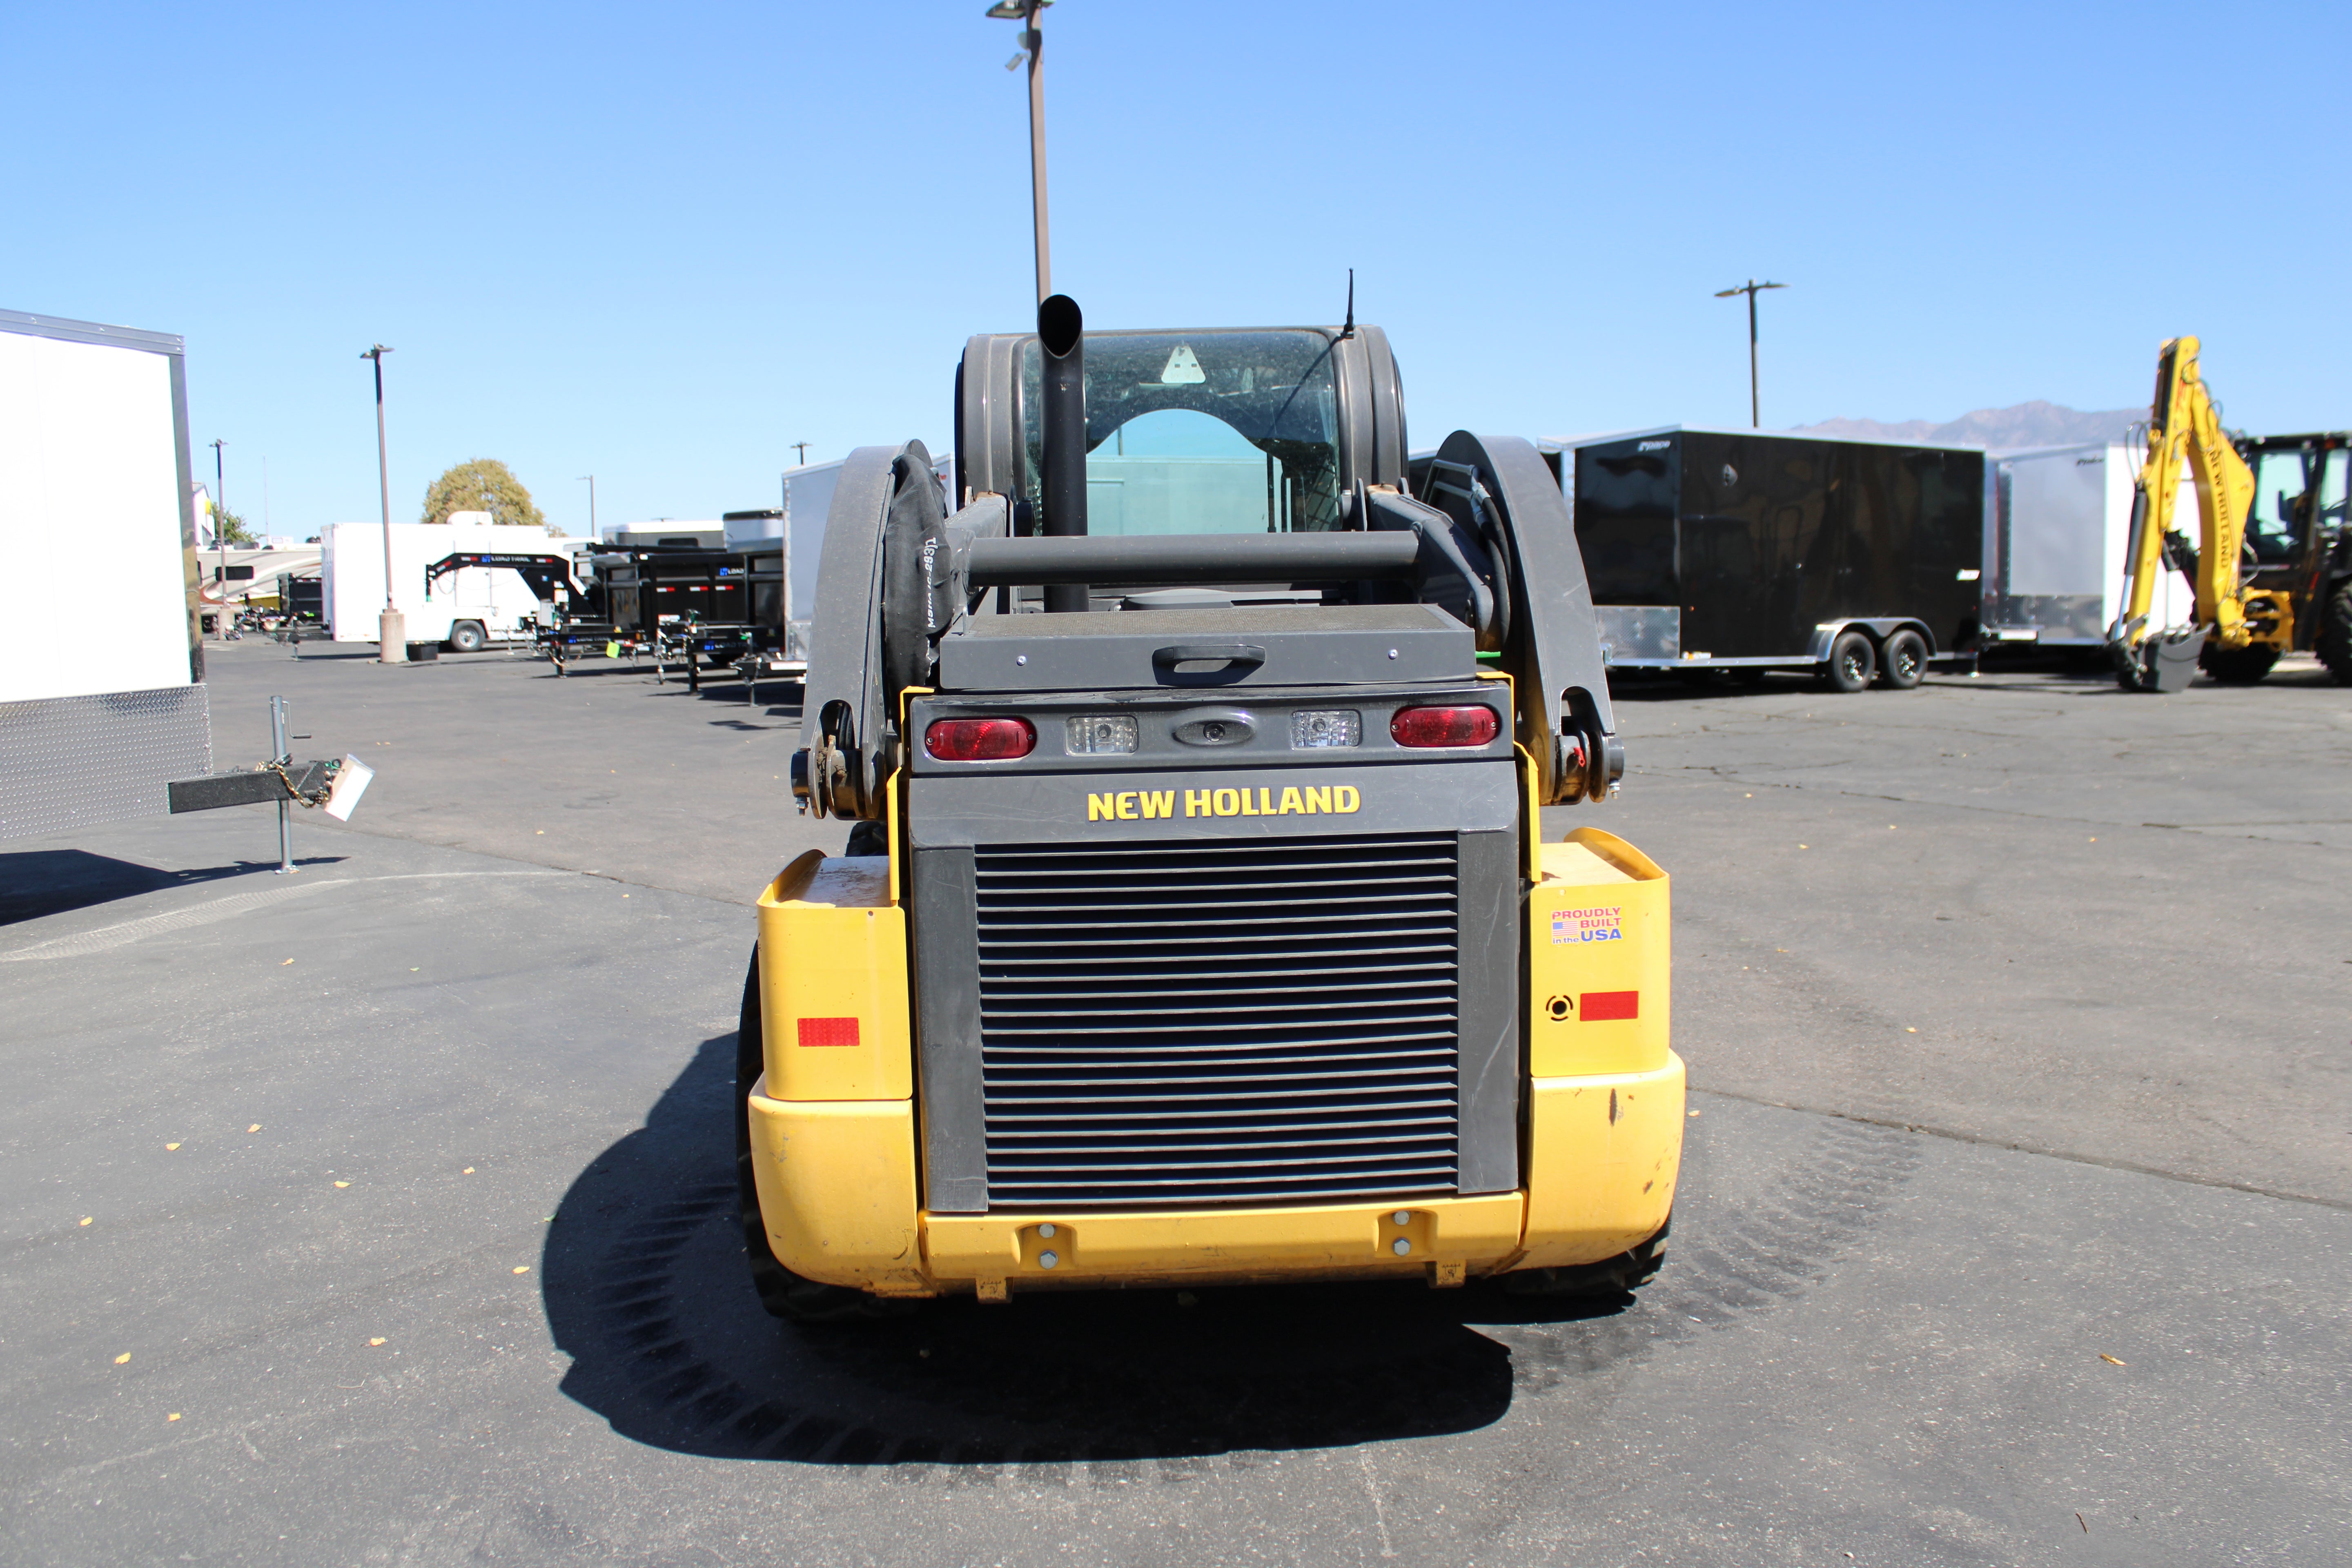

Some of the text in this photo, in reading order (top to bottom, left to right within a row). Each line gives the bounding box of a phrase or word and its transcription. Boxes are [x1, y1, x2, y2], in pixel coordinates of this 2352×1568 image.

[2209, 451, 2229, 568] NEW HOLLAND
[1088, 786, 1361, 821] NEW HOLLAND
[1552, 907, 1621, 920] PROUDLY
[1580, 918, 1622, 928] BUILT
[1581, 929, 1622, 942] USA
